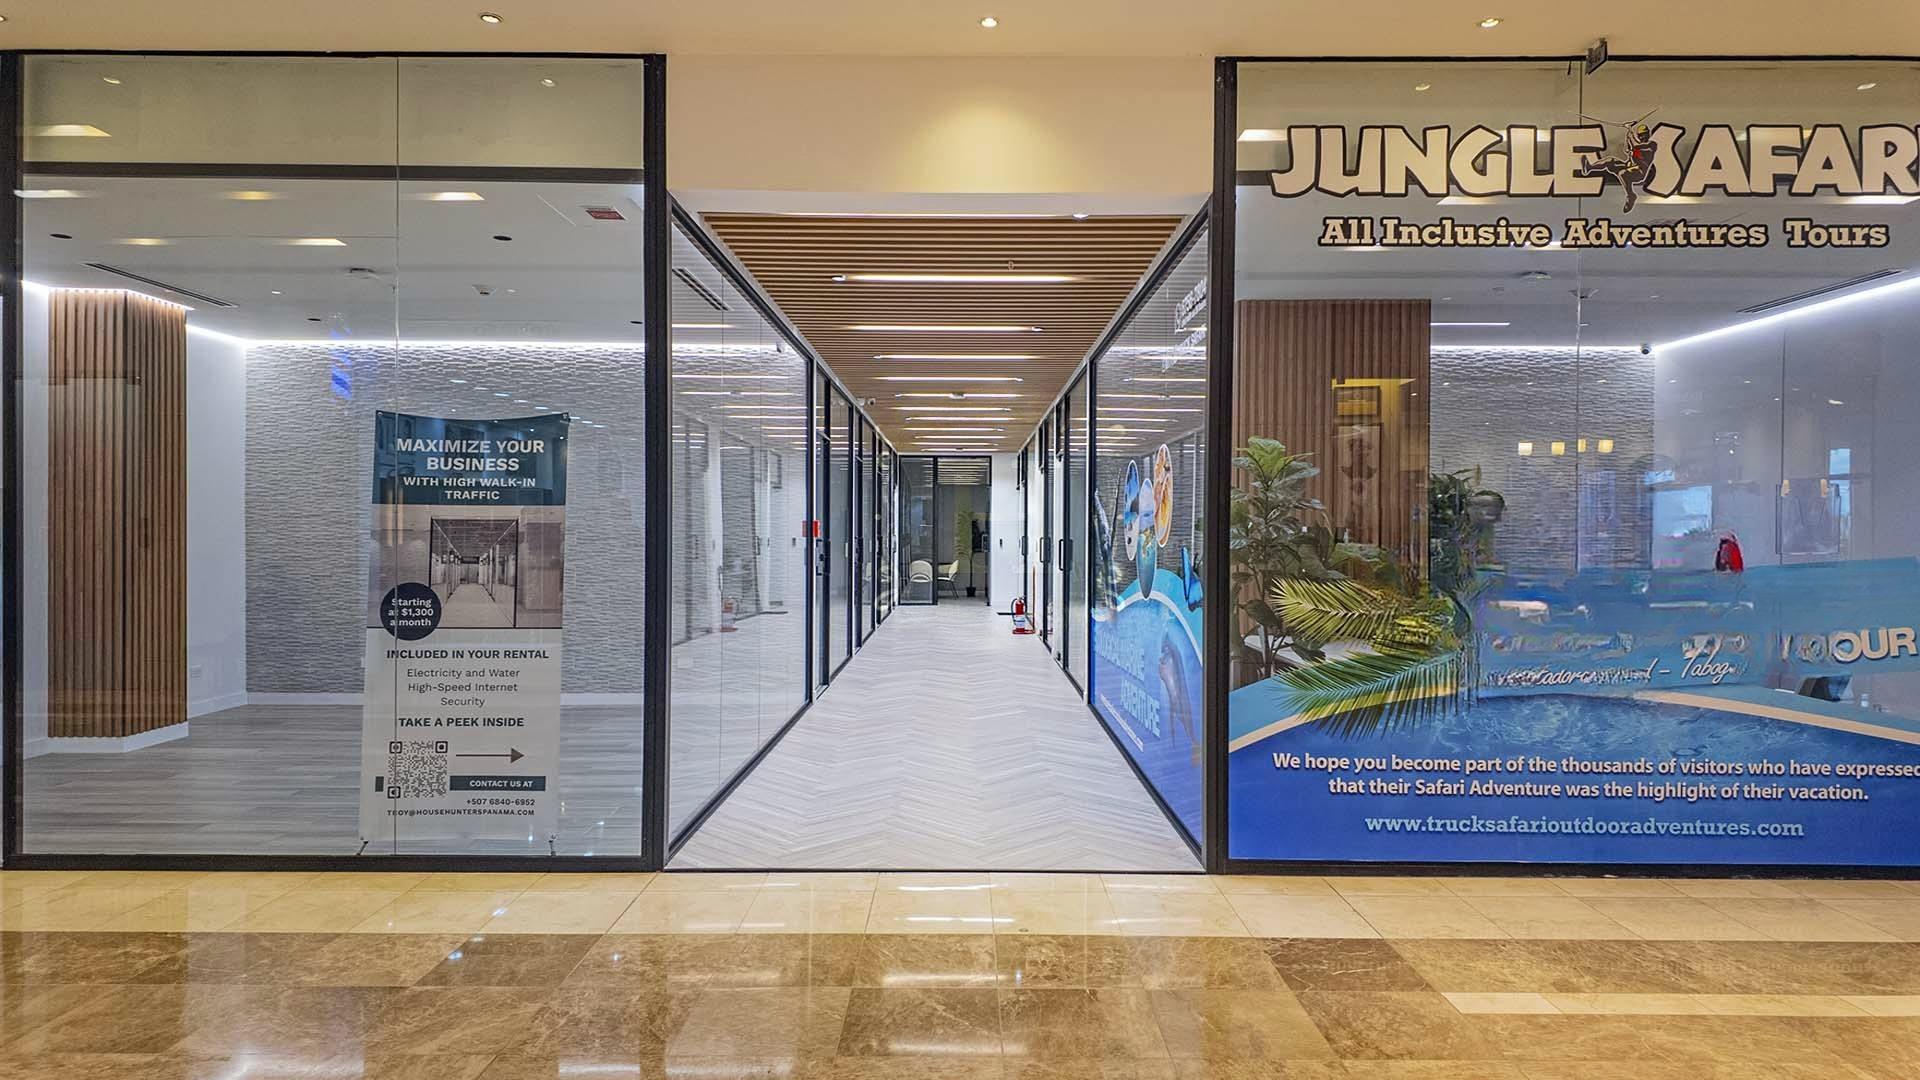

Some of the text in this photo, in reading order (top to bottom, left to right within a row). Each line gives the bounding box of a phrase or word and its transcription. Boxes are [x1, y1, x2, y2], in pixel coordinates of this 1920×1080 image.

[1270, 121, 1920, 198] JUNGLE SAFAR
[1318, 217, 1889, 249] All Inclusive Adventures Tours
[397, 438, 545, 454] MAXIMIZE YOUR
[427, 457, 520, 471] BUSINESS
[403, 476, 536, 488] WITH HIGH WALK-IN
[445, 490, 500, 500] TRAFFIC
[391, 597, 432, 608] Starting
[401, 608, 434, 617] $1,300
[399, 618, 431, 626] month
[387, 649, 549, 659] INCLUDED IN YOUR RENTAL
[407, 668, 521, 680] Electricity and Water
[407, 682, 518, 693] High-Speed Internet
[441, 696, 485, 708] Security
[398, 717, 525, 727] TAKE A PEEK INSIDE
[1273, 752, 1300, 769] We
[1304, 753, 1350, 773] hope
[1353, 757, 1386, 774] you
[1391, 754, 1460, 772] become
[1465, 757, 1502, 775] part
[1505, 755, 1525, 772] of
[1527, 756, 1557, 772] the
[1561, 756, 1653, 774] thousands
[1658, 758, 1677, 774] of
[1680, 758, 1743, 775] visitors
[1748, 759, 1785, 775] who
[1789, 760, 1831, 776] have
[469, 780, 534, 788] CONTACT US AT
[1328, 778, 1869, 801] that their Safari Adventure was the highlight of their vacation.
[466, 798, 487, 806] +507
[1364, 816, 1804, 838] www.trucksafarioutdooradventures.com
